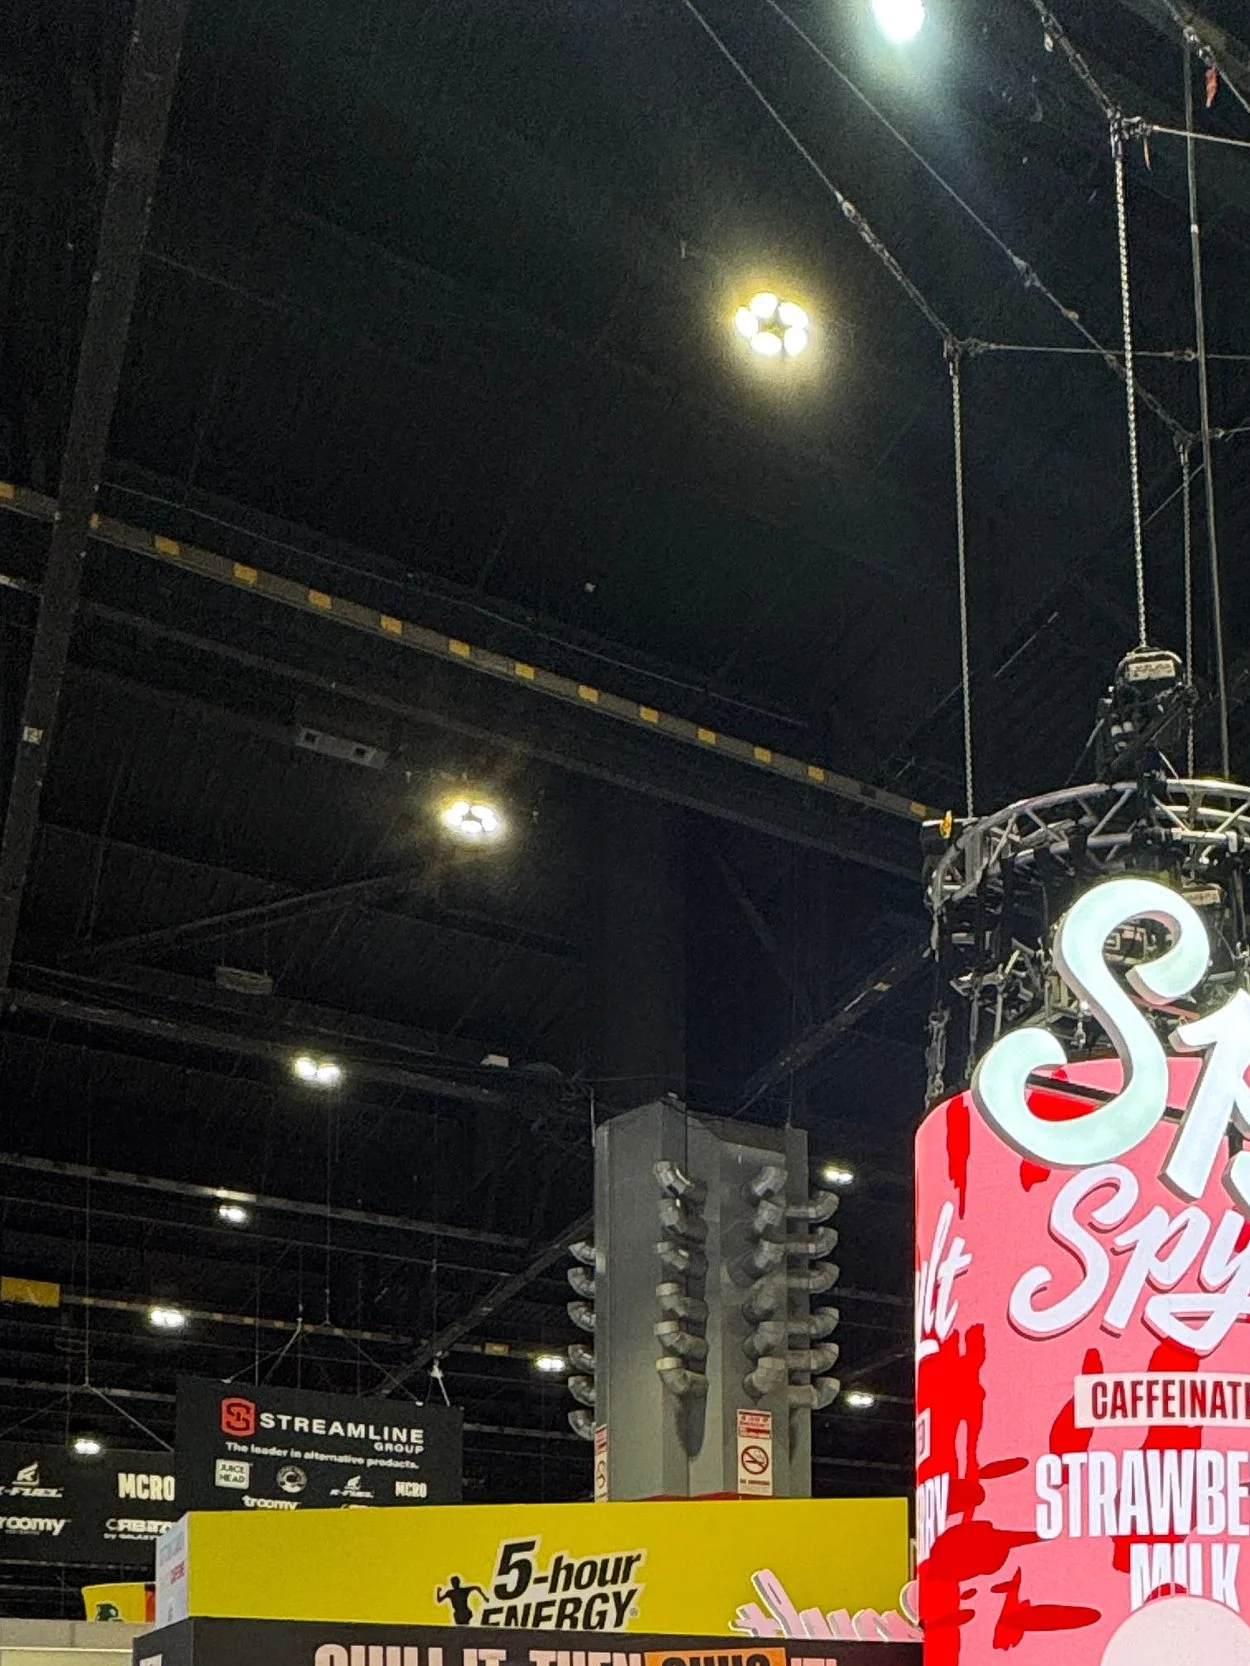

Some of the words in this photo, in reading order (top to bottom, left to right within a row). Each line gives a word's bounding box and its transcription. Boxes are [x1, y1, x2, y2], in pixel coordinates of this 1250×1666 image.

[259, 1412, 424, 1444] STREAMLINE
[225, 1441, 249, 1453] The
[251, 1444, 288, 1457] leader
[303, 1450, 365, 1465] alternative
[373, 1442, 424, 1454] GROUP
[118, 1473, 175, 1501] MCRO
[494, 1540, 642, 1600] 5-hour
